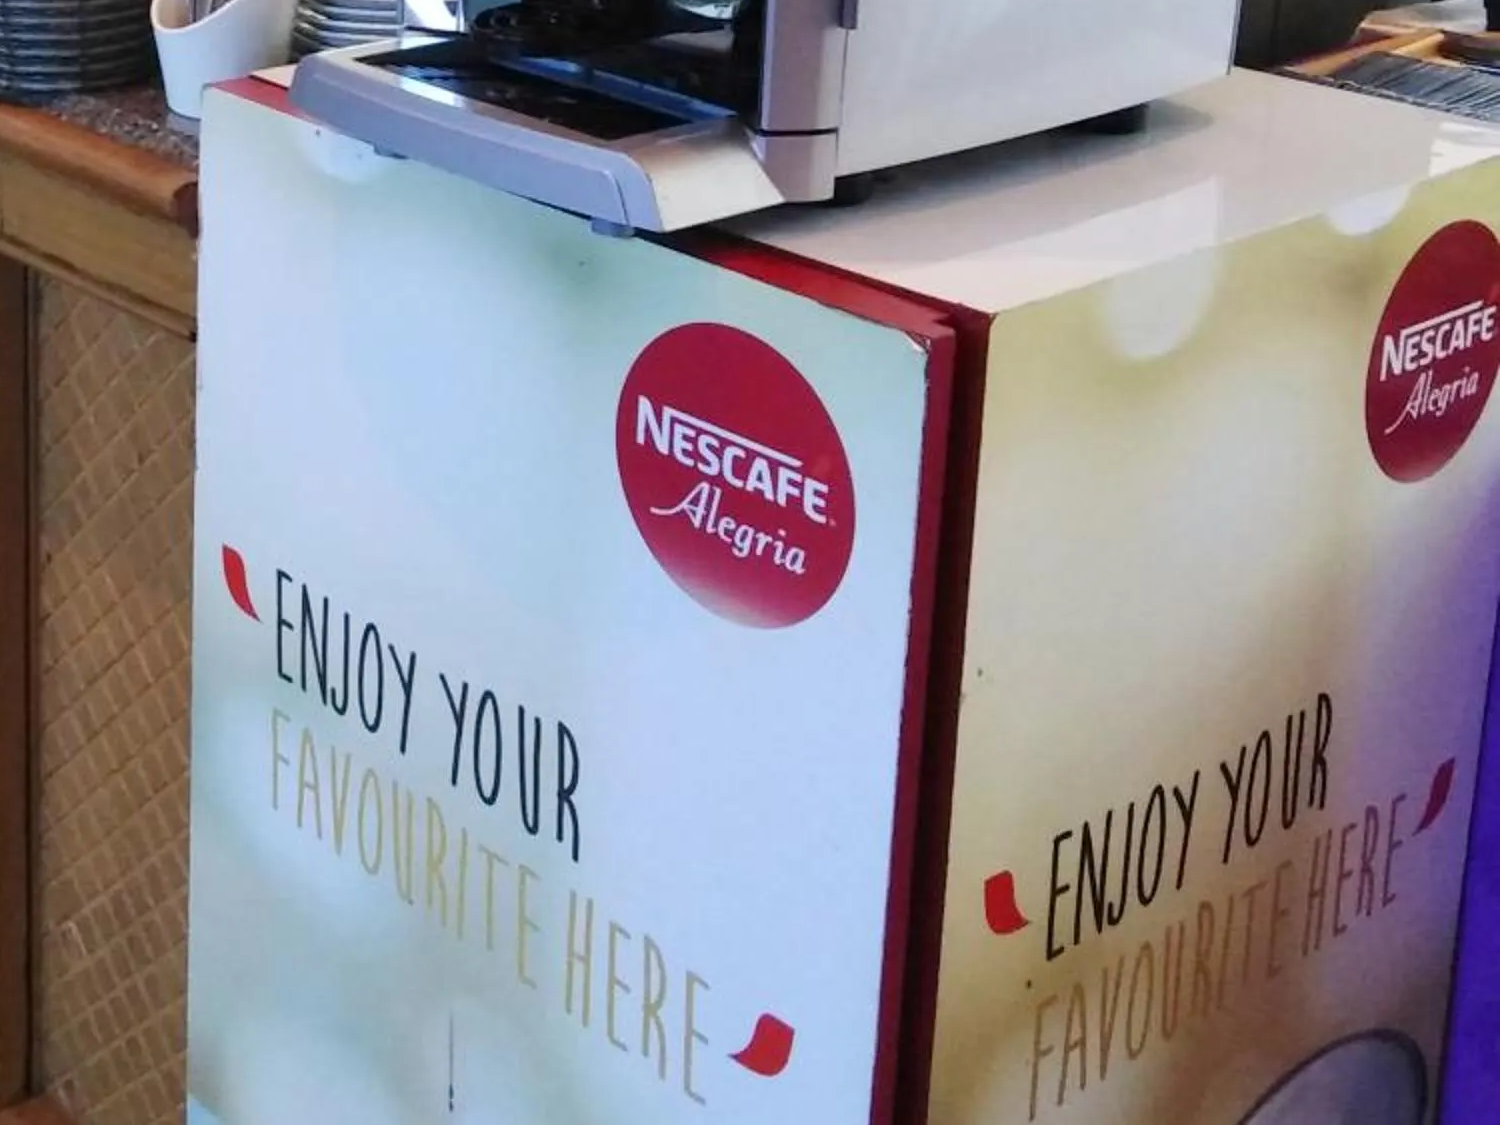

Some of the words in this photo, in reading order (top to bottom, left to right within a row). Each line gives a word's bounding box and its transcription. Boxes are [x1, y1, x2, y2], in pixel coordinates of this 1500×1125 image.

[649, 481, 807, 575] Alegria
[1384, 366, 1479, 434] Alegria
[276, 569, 417, 754] ENJOY
[438, 673, 580, 862] YOUR
[1046, 769, 1201, 961] ENJOY
[1219, 692, 1333, 864] YOUR
[271, 708, 541, 989] FAVOURITE
[564, 889, 711, 1107] HERE
[1028, 859, 1294, 1123] FAVOURITE
[1302, 793, 1407, 958] HERE
